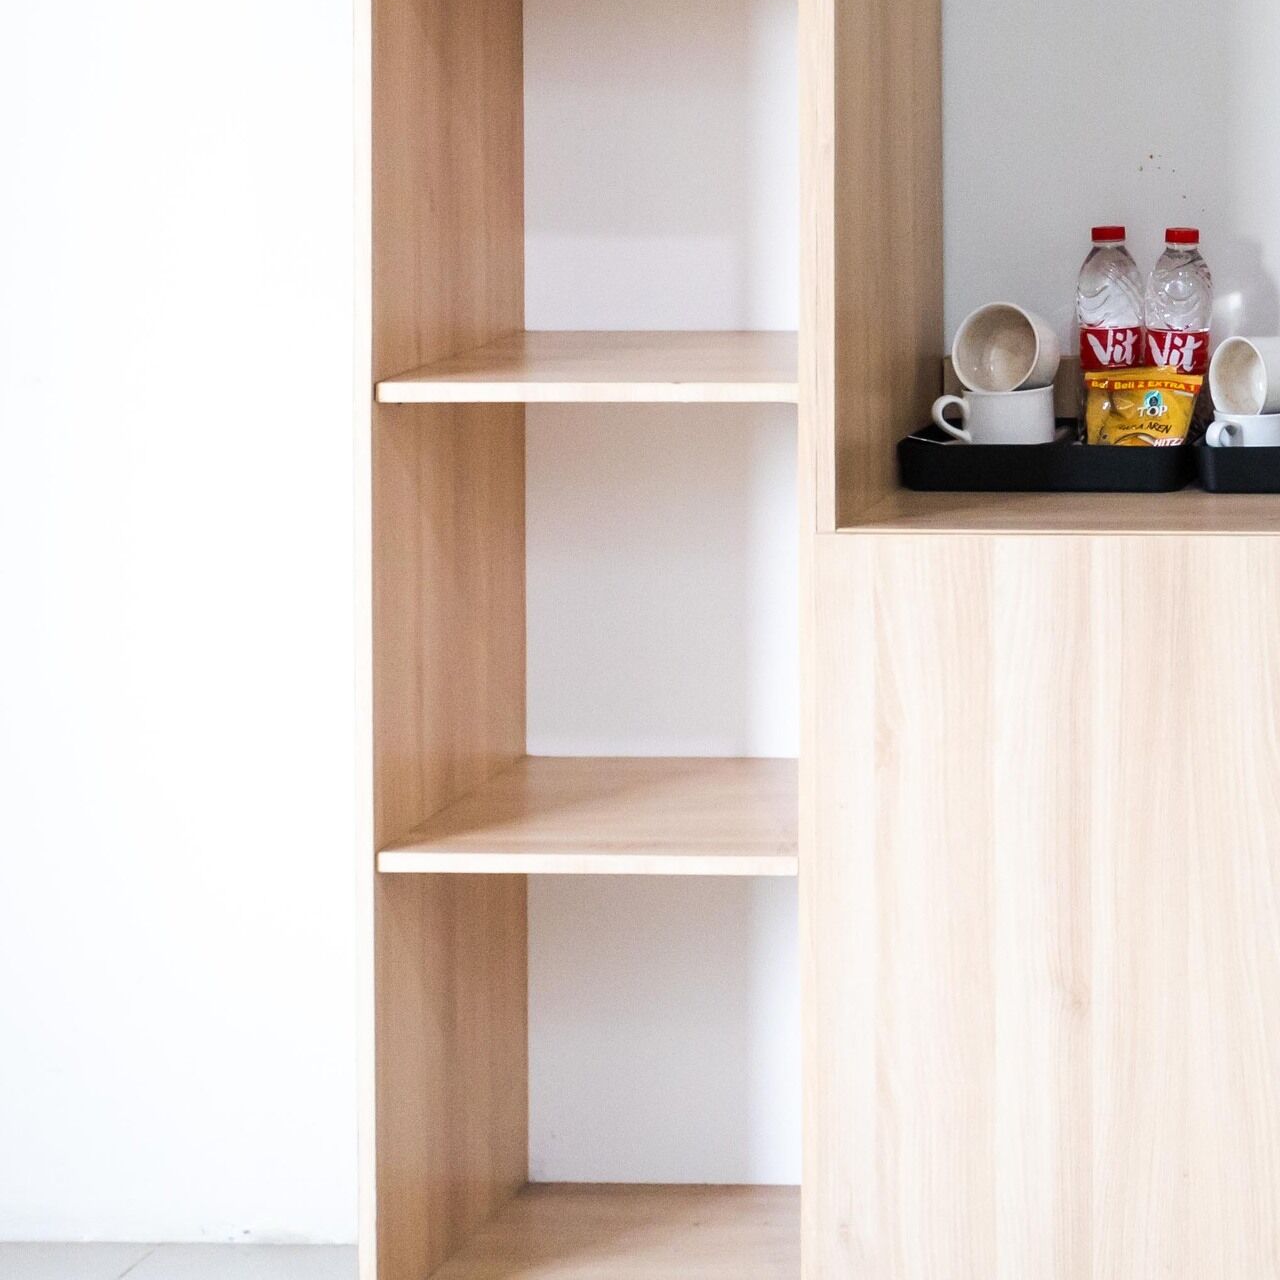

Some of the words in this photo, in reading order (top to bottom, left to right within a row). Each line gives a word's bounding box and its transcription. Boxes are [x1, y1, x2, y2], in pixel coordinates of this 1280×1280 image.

[1087, 328, 1138, 366] Vit
[1147, 331, 1203, 372] Vit
[1147, 381, 1185, 390] EXTRA
[1137, 405, 1168, 418] TOP
[1147, 421, 1173, 434] AREN
